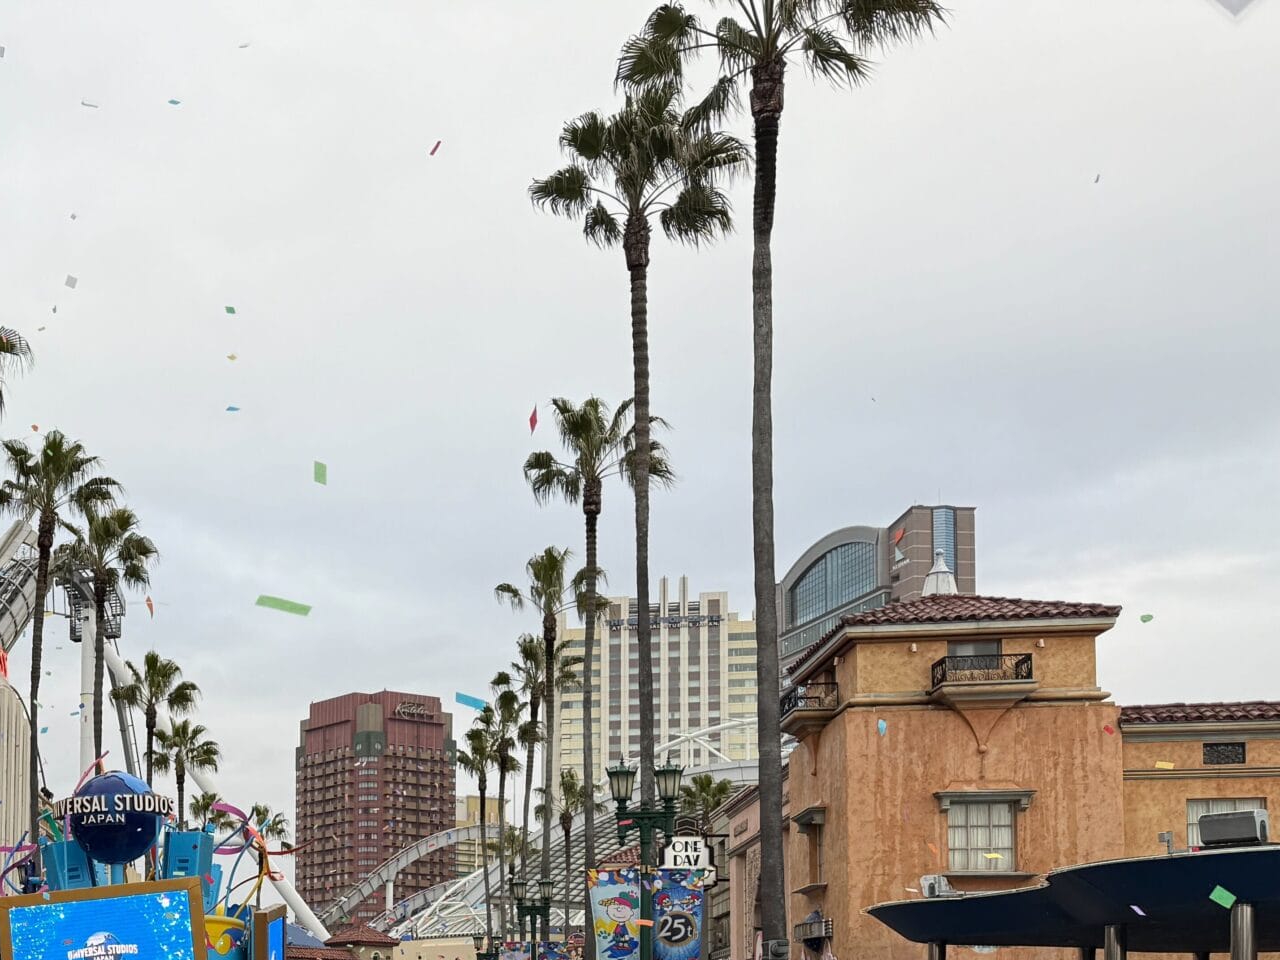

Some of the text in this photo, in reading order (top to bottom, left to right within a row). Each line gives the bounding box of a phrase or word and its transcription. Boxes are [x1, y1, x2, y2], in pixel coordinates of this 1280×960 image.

[114, 794, 176, 815] STUDIOS
[81, 813, 126, 825] JAPAN
[672, 840, 702, 852] ONE
[673, 854, 700, 866] DAY
[67, 944, 139, 960] UNIVERSAL STUDIOS
